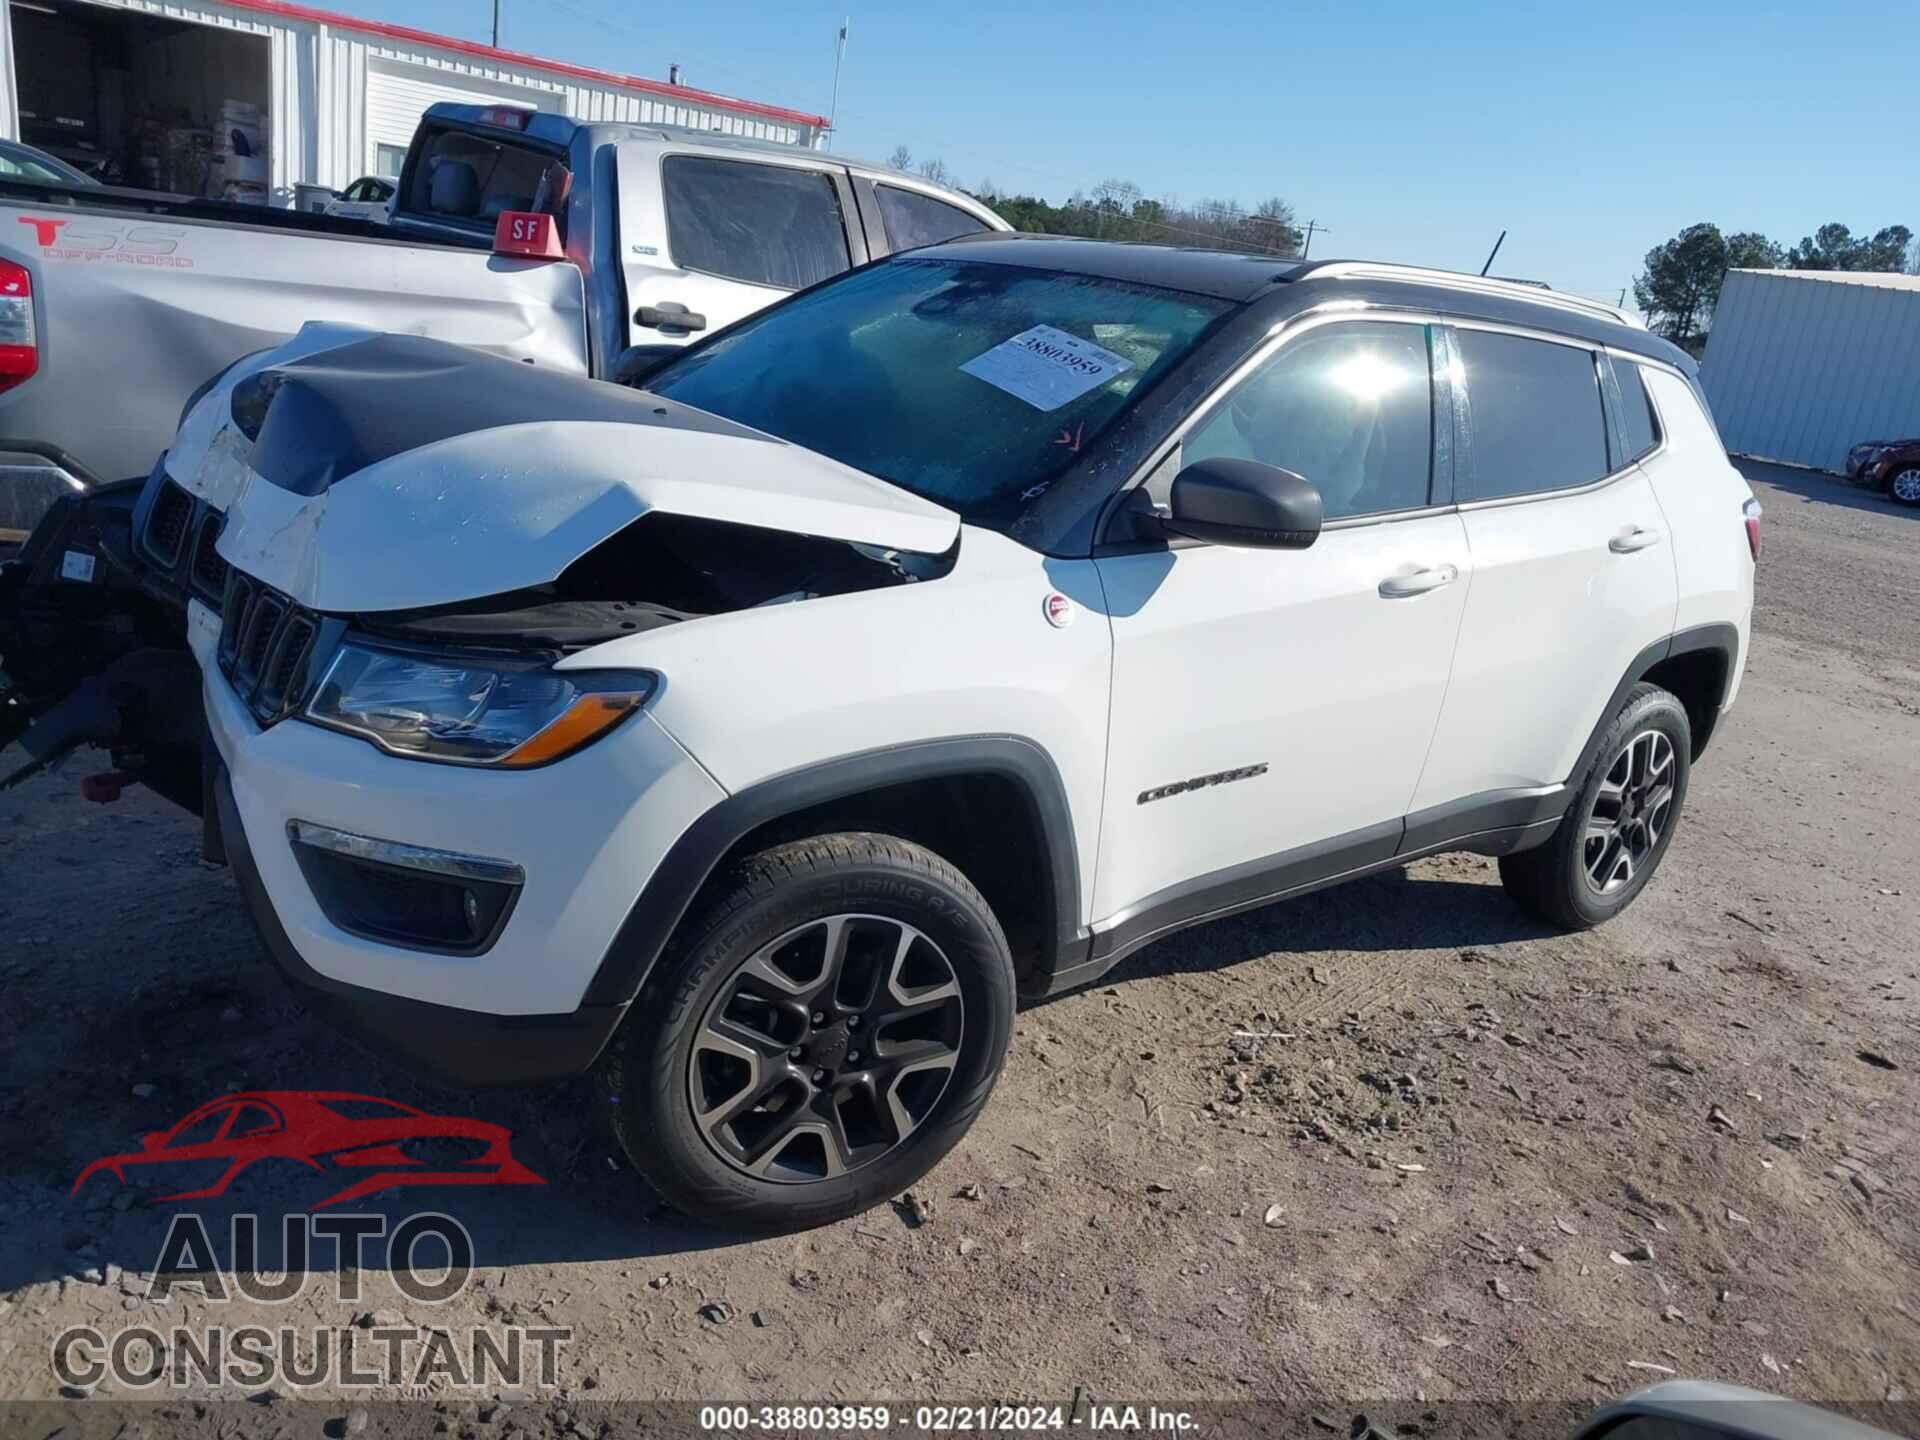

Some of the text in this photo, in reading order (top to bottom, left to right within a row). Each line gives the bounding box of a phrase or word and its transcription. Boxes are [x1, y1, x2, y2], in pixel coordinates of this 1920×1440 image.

[44, 248, 194, 268] OFF-ROAD
[1018, 337, 1103, 376] 38803959
[1136, 762, 1269, 805] COMPASS
